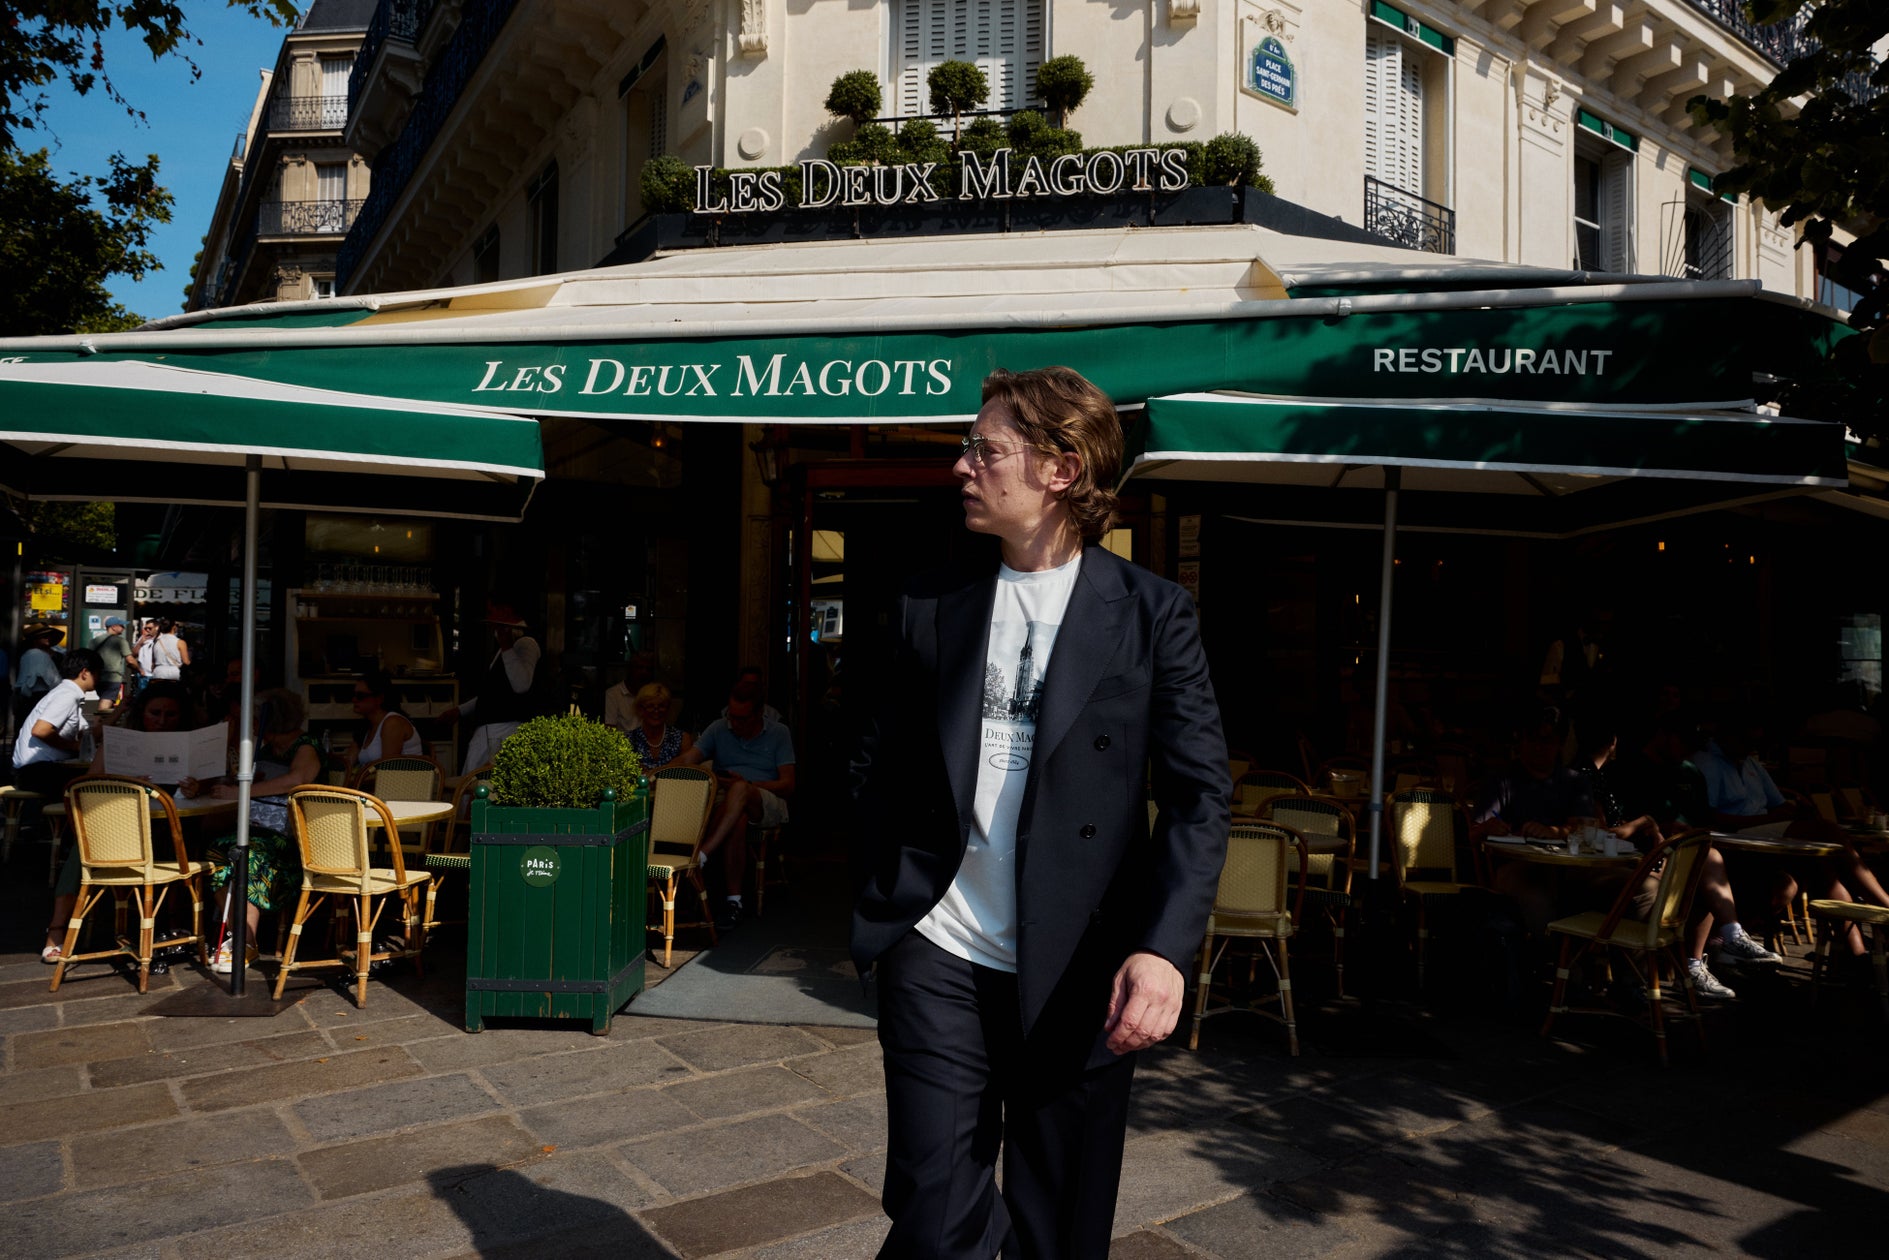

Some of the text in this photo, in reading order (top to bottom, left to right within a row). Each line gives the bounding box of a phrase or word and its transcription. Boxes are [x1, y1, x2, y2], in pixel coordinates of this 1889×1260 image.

[1265, 59, 1282, 73] PLACE
[1256, 66, 1290, 87] SAINT-GERMAIN
[1261, 79, 1285, 96] DES PRÉS
[694, 147, 1189, 214] LES DEUX MAGOTS
[1373, 347, 1613, 376] RESTAURANT
[472, 353, 953, 397] LES DEUX MAGOTS
[136, 589, 163, 599] DE
[985, 728, 1014, 743] DEUX
